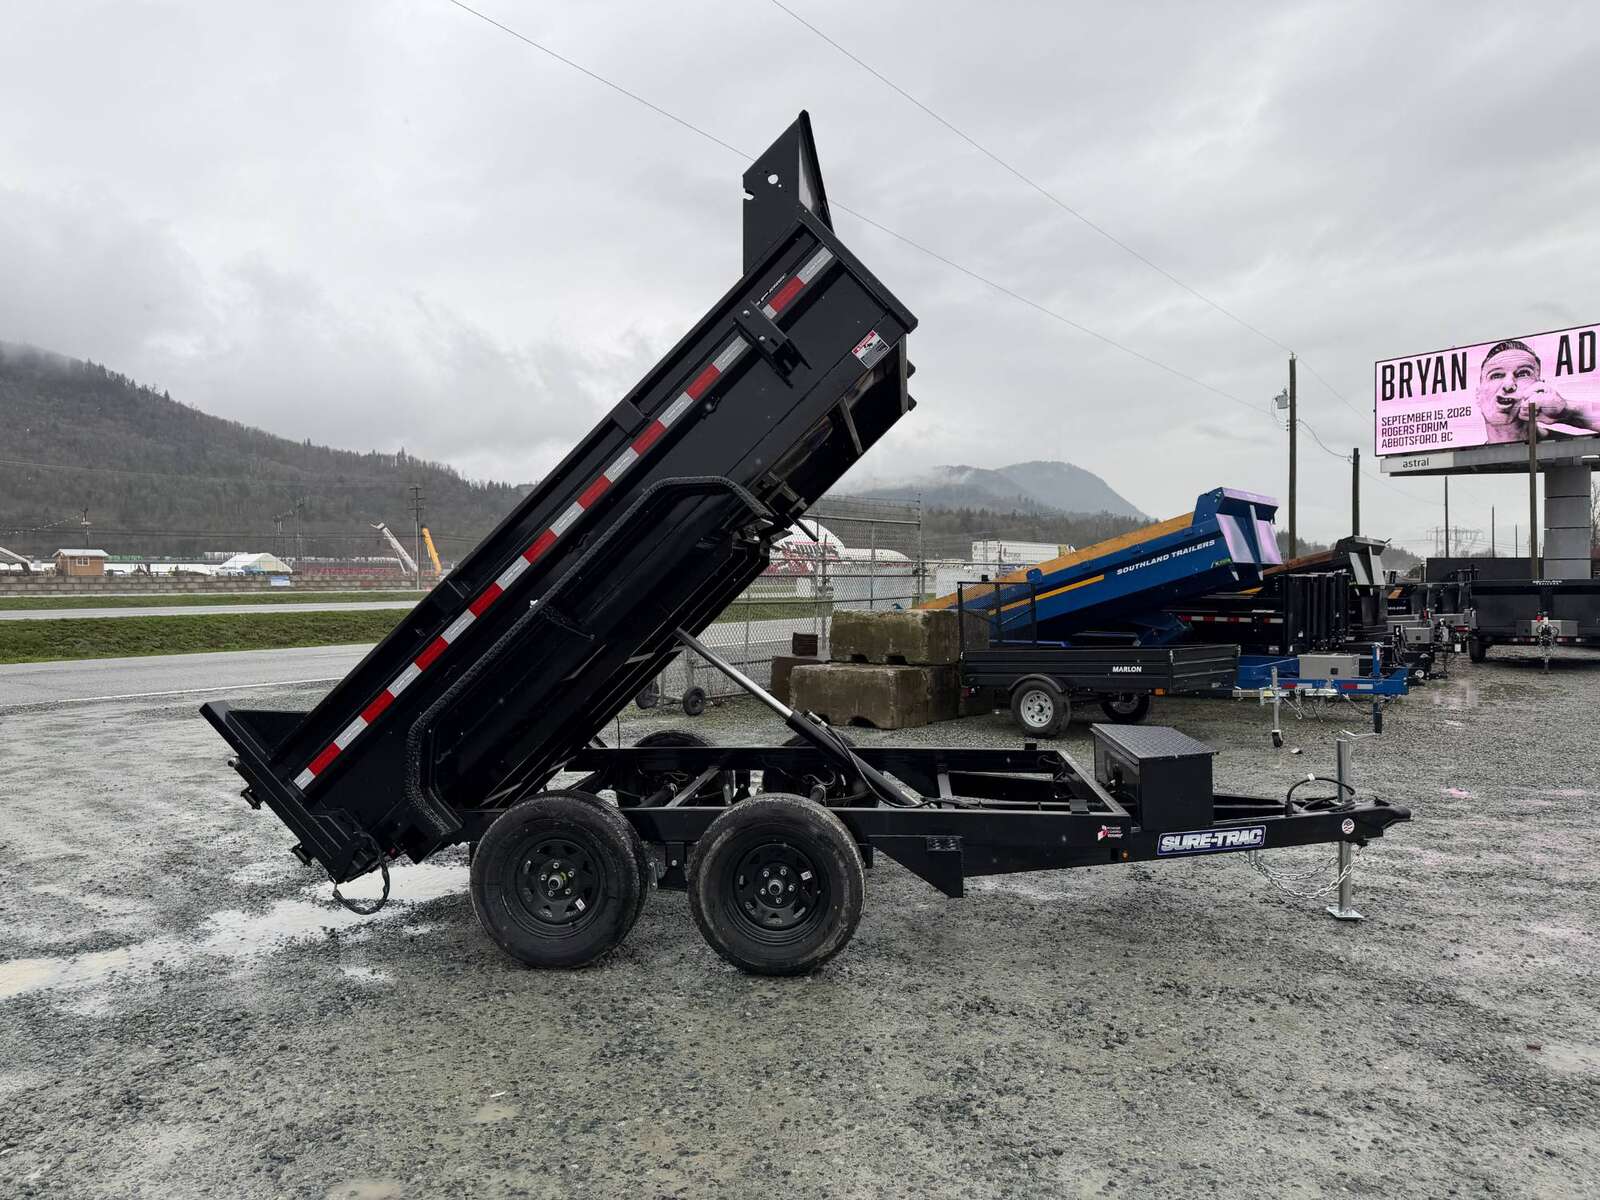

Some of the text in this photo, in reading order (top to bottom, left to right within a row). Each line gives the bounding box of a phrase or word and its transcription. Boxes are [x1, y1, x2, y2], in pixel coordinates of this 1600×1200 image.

[1381, 330, 1596, 401] BRYAN AD
[1381, 411, 1432, 427] SEPTEMBER
[1447, 406, 1472, 419] 2026
[1381, 420, 1448, 437] ROGERS FORUM
[1381, 432, 1453, 449] ABBOTSFORD, BC
[1402, 457, 1430, 468] astral
[1116, 539, 1216, 575] SOUTHLAND TRAILERS
[1112, 665, 1142, 673] MARLON
[1161, 829, 1263, 852] SURE-TRAC
